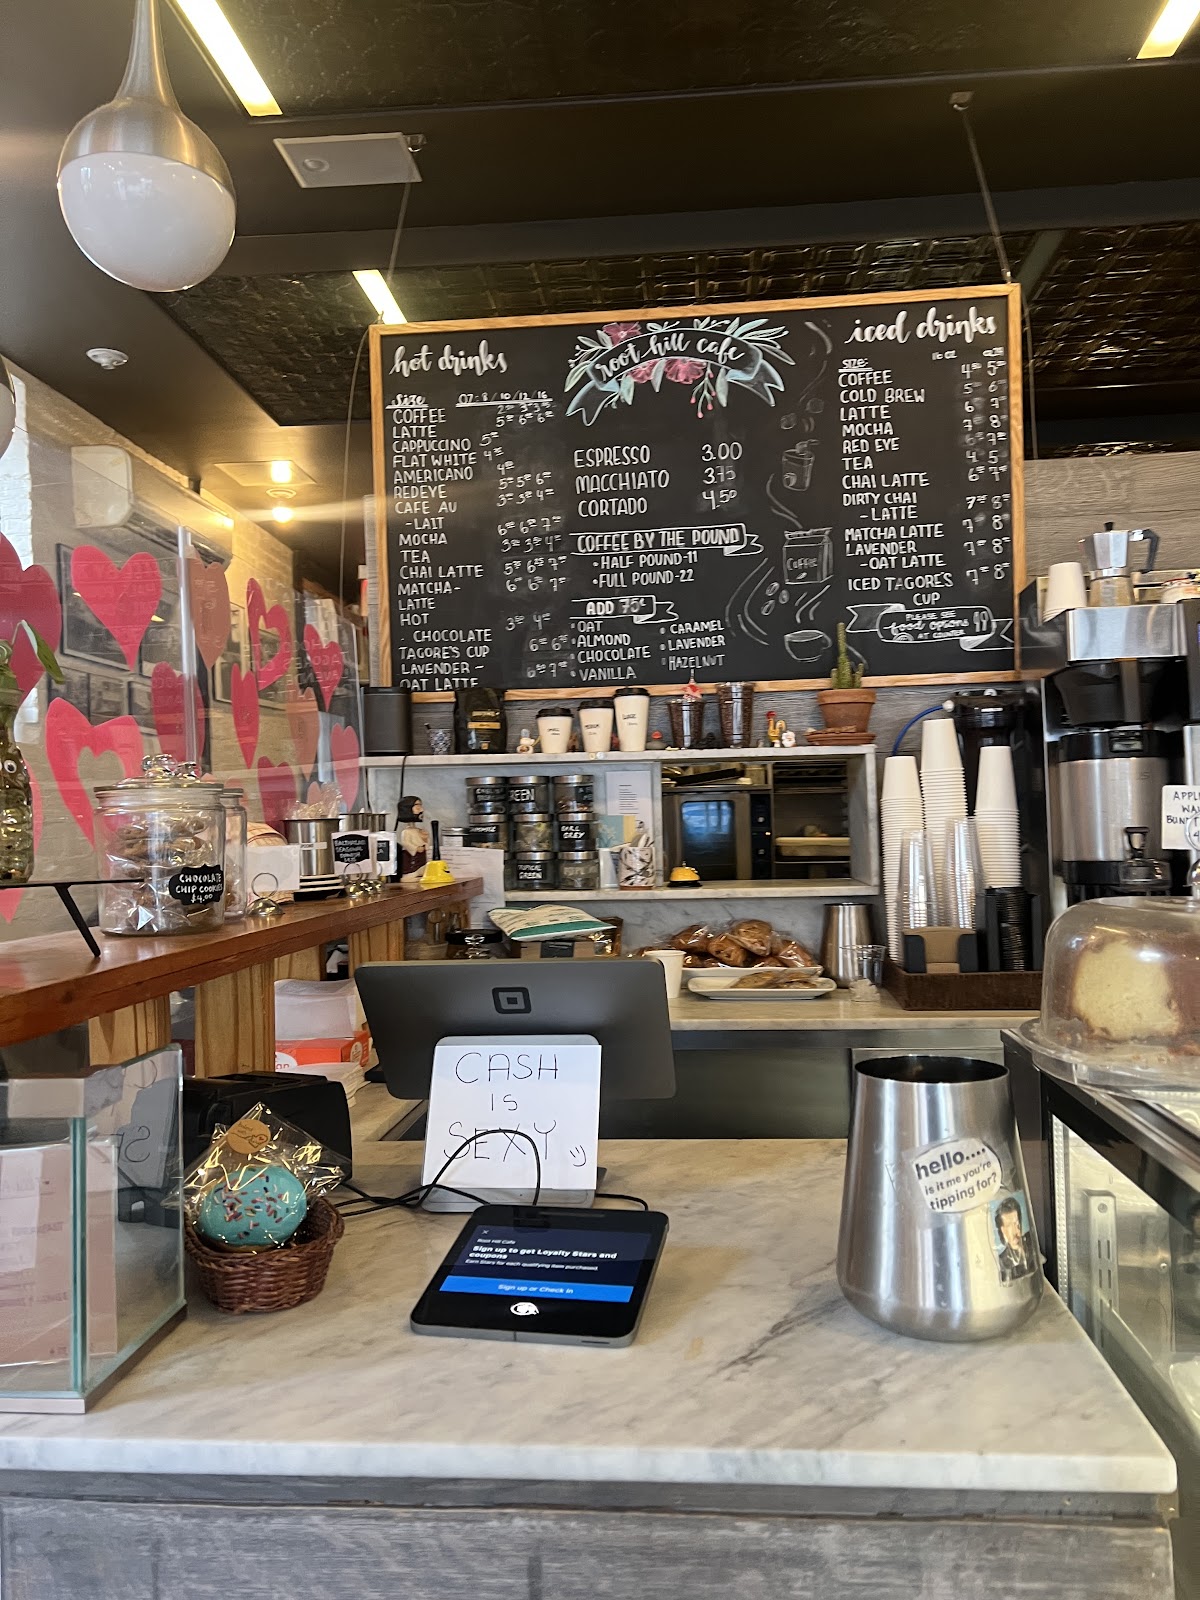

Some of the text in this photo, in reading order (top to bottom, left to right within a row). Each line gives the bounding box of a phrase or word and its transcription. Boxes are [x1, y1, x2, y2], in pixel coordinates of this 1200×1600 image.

[844, 306, 997, 344] iced drinks
[389, 340, 507, 377] hot drinks
[595, 332, 745, 381] root hill cafe
[838, 370, 892, 387] COFFEE
[840, 387, 925, 404] COLD BREW
[392, 408, 447, 424] COFFEE
[840, 405, 891, 421] LATTE
[392, 425, 437, 438] LATTE
[842, 422, 894, 437] MOCHA
[392, 438, 472, 453] CAPPUCCINO
[842, 437, 900, 454] RED EYE
[393, 455, 428, 468] FLAT
[431, 452, 477, 466] WHITE
[574, 442, 743, 468] ESPRESSO 3.00
[842, 456, 874, 470] TEA
[394, 467, 474, 484] AMERICANO
[575, 465, 737, 494] MACCHIATO 3.75
[842, 472, 930, 489] CHAI LATTE
[394, 484, 447, 499] REDEYE
[842, 492, 917, 506] DIRTY CHAI
[395, 501, 430, 514] CAFE
[438, 501, 457, 513] AU
[578, 497, 648, 517] CORTADO
[398, 533, 448, 546] MOCHA
[844, 523, 944, 541] MATCHA LATTE
[577, 528, 740, 553] COFFEE BY THE POUND
[846, 540, 917, 556] LAVENDER
[400, 550, 430, 563] TEA
[600, 556, 634, 569] HALF
[901, 553, 947, 568] LATTE
[400, 565, 433, 580] CHAI
[438, 564, 484, 578] LATTE
[599, 573, 627, 588] FULL
[848, 577, 881, 591] ICED
[398, 598, 436, 610] LATTE
[913, 592, 941, 606] CUP
[586, 602, 615, 615] ADD
[400, 613, 429, 626] HOT
[577, 621, 603, 633] OAT
[669, 620, 724, 634] CARAMEL
[413, 629, 493, 643] CHOCOLATE
[577, 633, 631, 647] ALMOND
[667, 635, 726, 651] LAVENDER
[466, 645, 490, 658] CUP
[577, 646, 651, 663] CHOCOLATE
[401, 662, 470, 675] LAVENDER
[668, 654, 726, 670] HAZELNUT
[579, 666, 637, 681] VANILLA
[1173, 791, 1200, 801] APPL
[175, 885, 197, 893] CHIP
[455, 1052, 559, 1083] CASH
[491, 1093, 518, 1112] IS
[444, 1120, 557, 1162] SEXY
[925, 1160, 992, 1196] is it me you're
[930, 1172, 998, 1211] tipping for?
[469, 1252, 508, 1260] coupons
[473, 1246, 494, 1254] Sign
[520, 1248, 536, 1256] get
[537, 1249, 571, 1258] Loyalty
